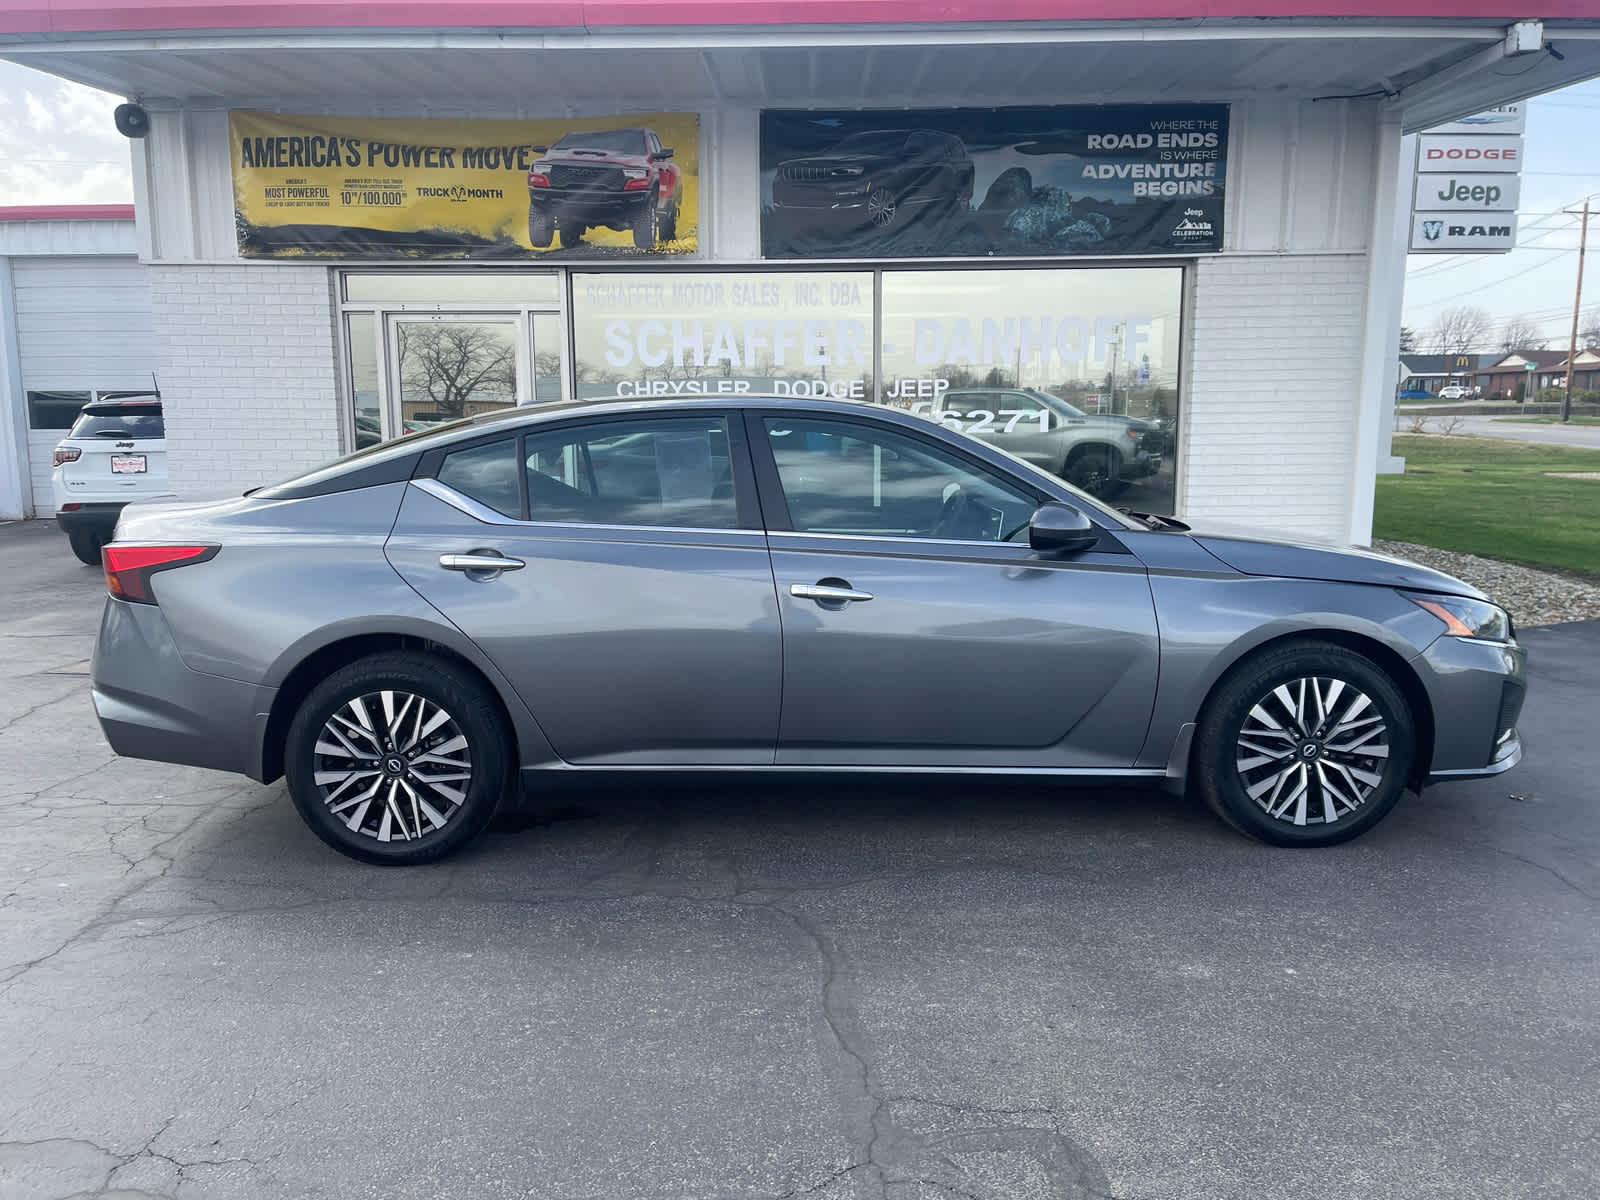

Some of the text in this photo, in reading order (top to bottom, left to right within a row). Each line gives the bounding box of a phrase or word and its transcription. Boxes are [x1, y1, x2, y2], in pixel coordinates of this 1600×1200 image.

[1151, 120, 1219, 130] WHERE THE
[1087, 132, 1218, 149] ROAD ENDS
[241, 136, 361, 168] AMERICA'S
[367, 141, 457, 168] POWER
[1160, 150, 1218, 160] IS WHERE
[1427, 149, 1517, 160] DODGE
[1081, 162, 1216, 179] ADVENTURE
[264, 187, 330, 198] MOST POWERFUL
[416, 187, 503, 198] TRUCK MONTH
[1133, 181, 1214, 196] BEGINS
[1438, 179, 1500, 206] Jeep
[1184, 207, 1204, 217] Jeep
[1448, 226, 1511, 237] RAM
[587, 283, 664, 308] SCHAFFER
[671, 282, 724, 307] MOTOR
[830, 281, 861, 305] DBA
[605, 319, 866, 367] SCHAFFER
[914, 317, 1153, 364] DANHOFF
[616, 379, 950, 398] CHRYSLER DODGE JEEP
